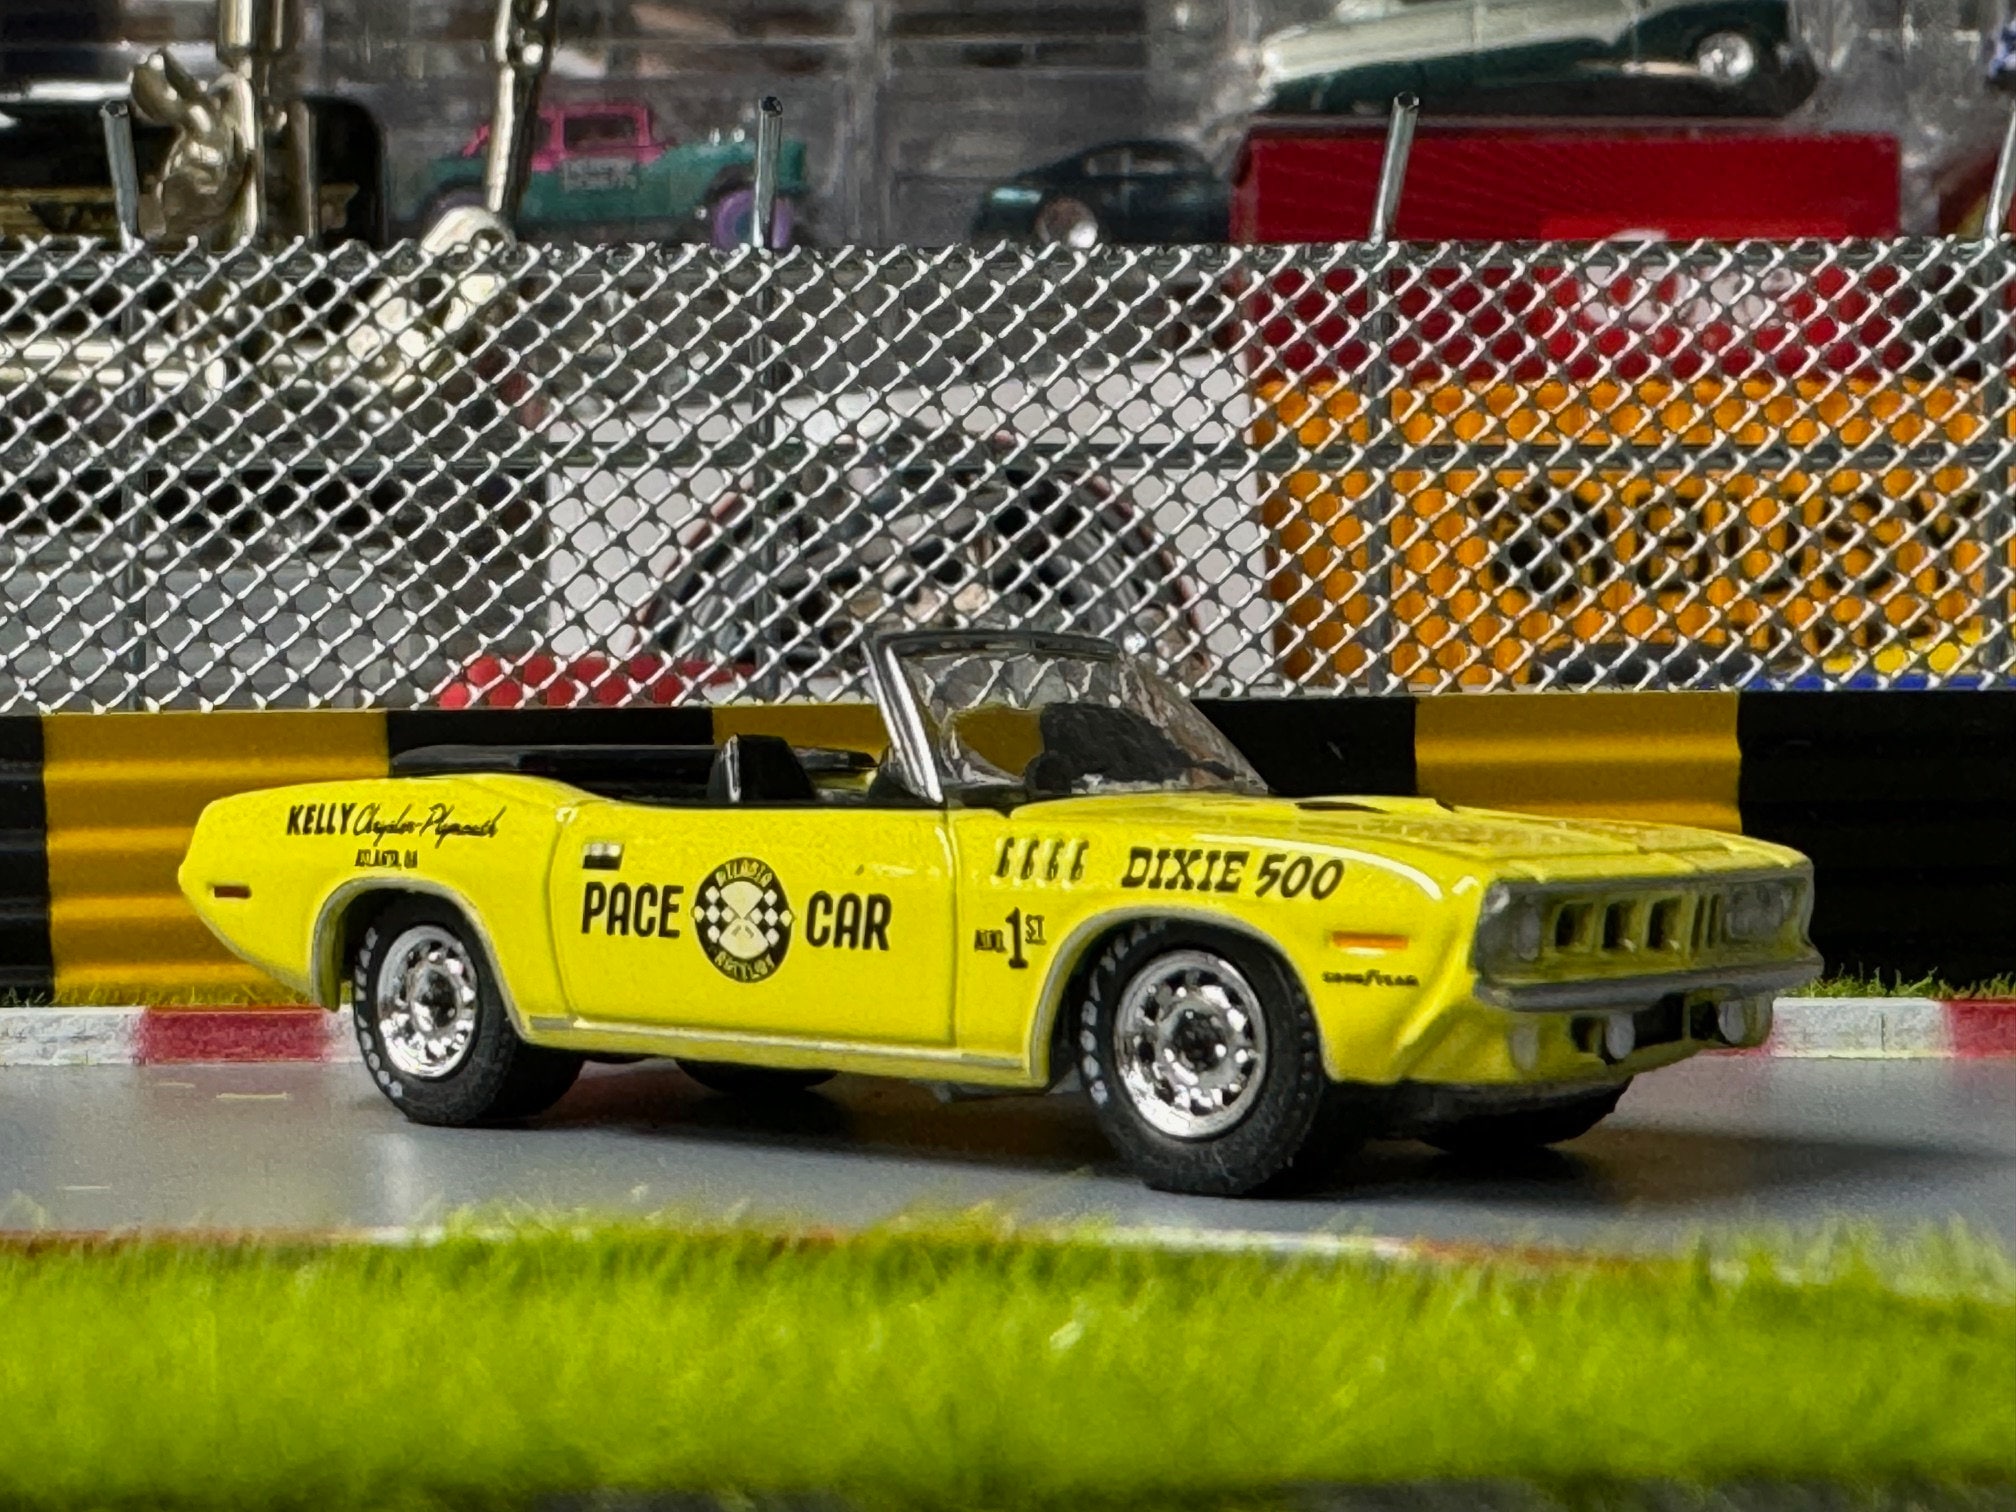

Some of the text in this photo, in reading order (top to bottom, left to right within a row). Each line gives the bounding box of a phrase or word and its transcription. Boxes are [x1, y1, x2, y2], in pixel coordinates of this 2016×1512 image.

[286, 803, 356, 835] KELLY
[1121, 846, 1344, 900] DIXIE 500
[581, 881, 892, 951] PACE CAR
